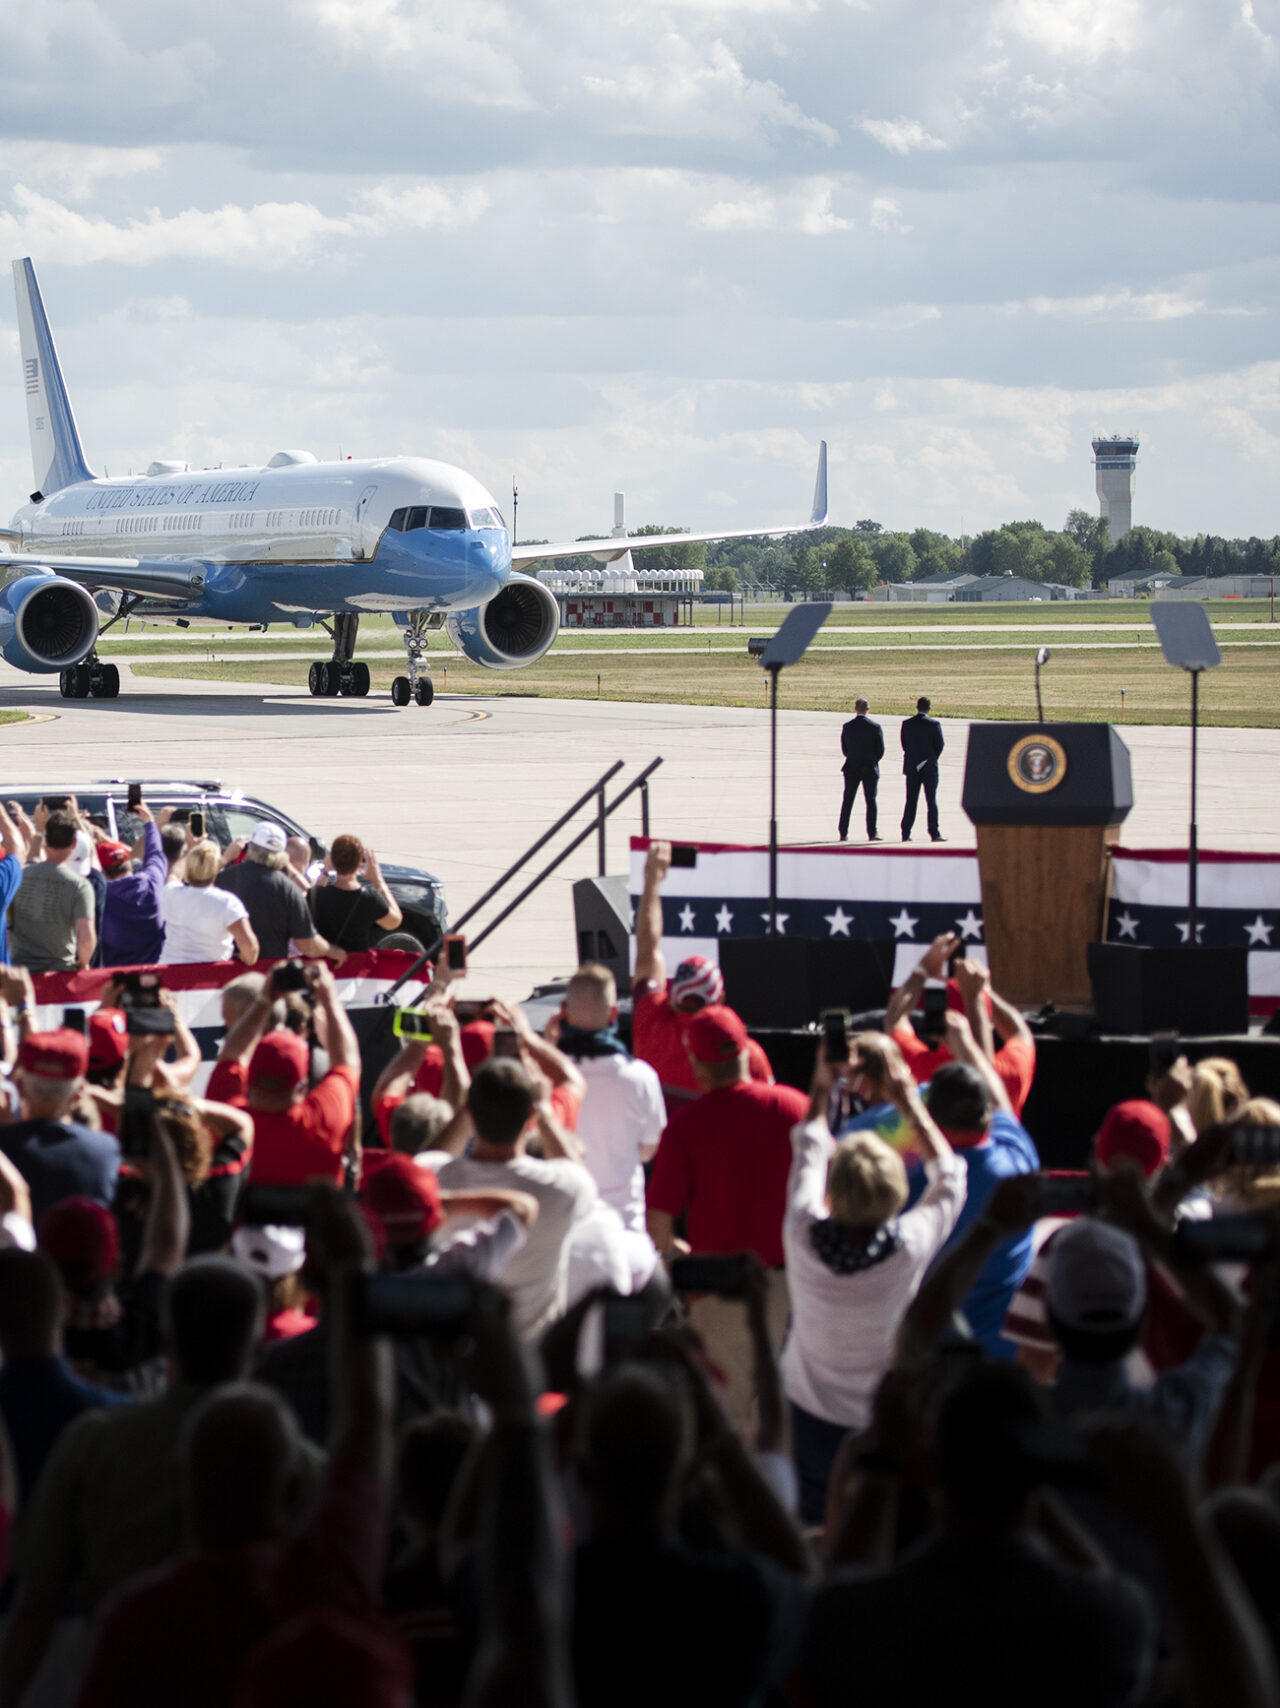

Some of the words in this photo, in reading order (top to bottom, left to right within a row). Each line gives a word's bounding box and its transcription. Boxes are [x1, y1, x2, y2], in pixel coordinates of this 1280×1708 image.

[86, 488, 135, 510] UNITED
[130, 486, 180, 507] STATES
[176, 484, 203, 504] OF
[195, 481, 261, 504] AMERICA
